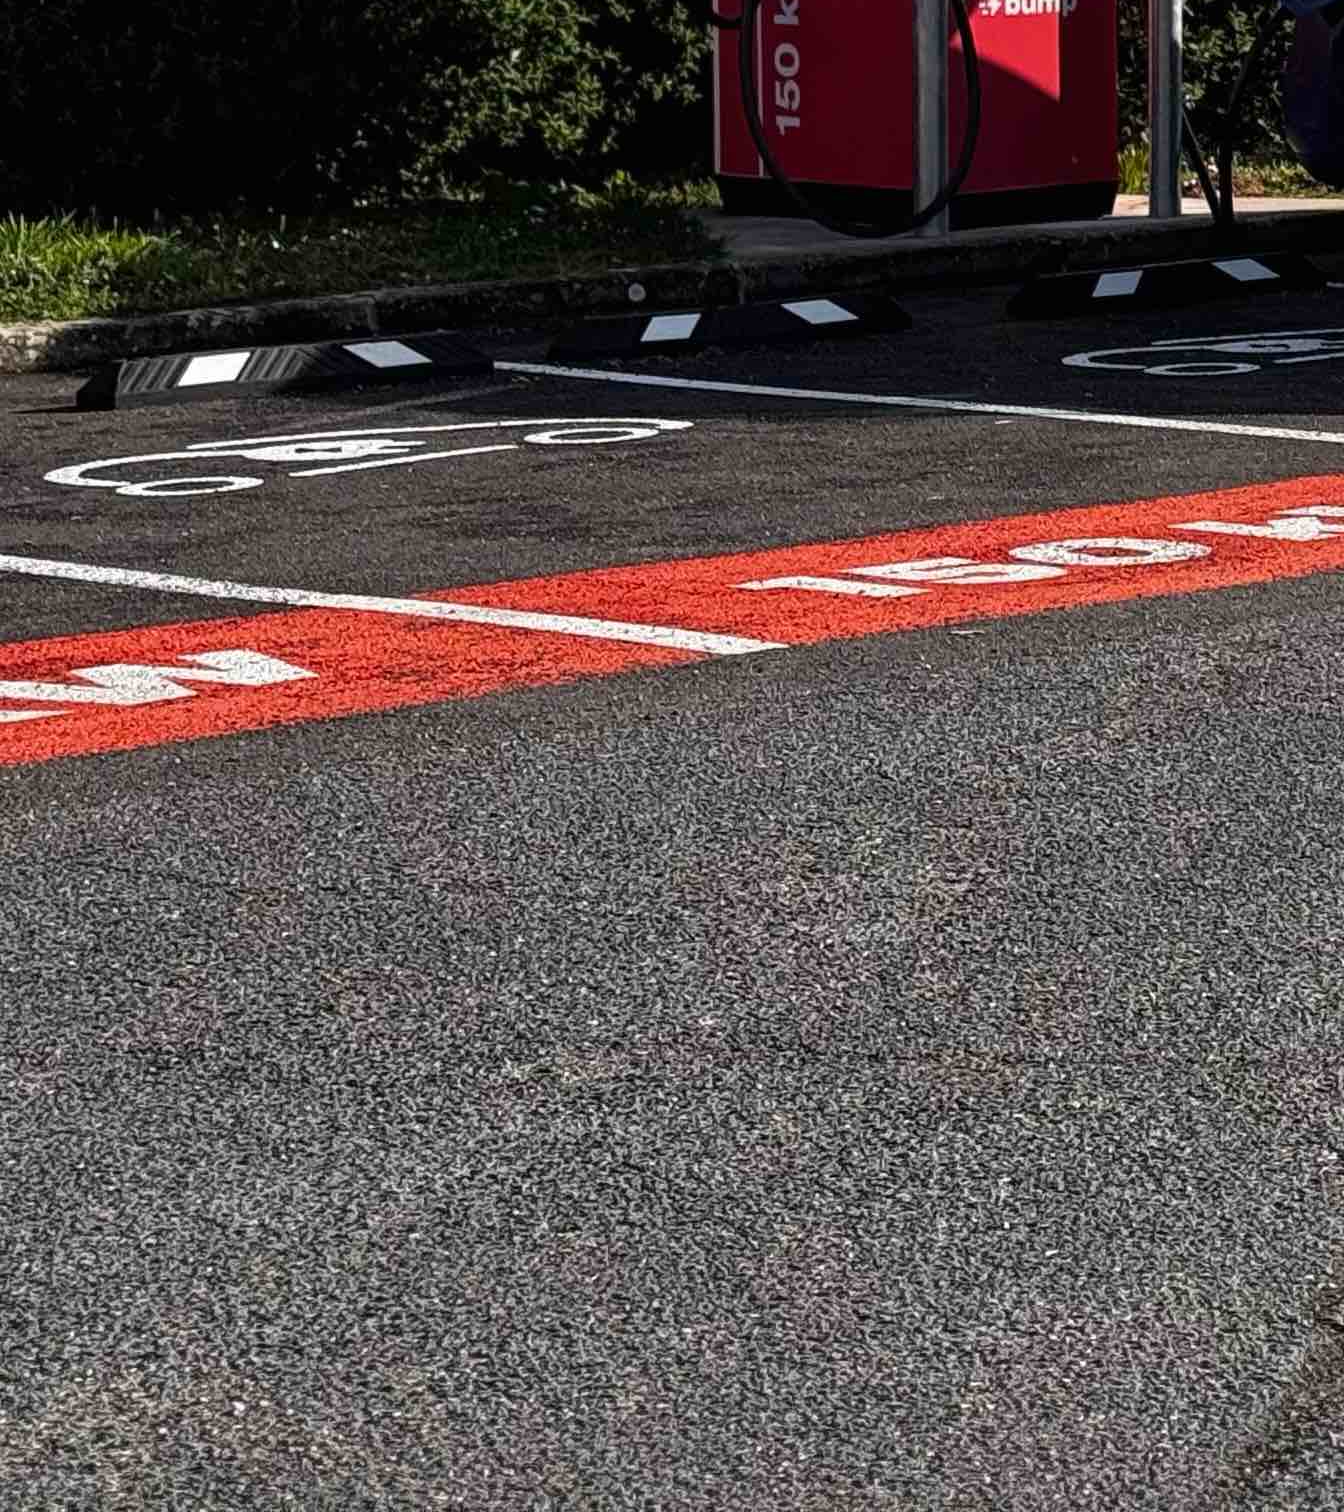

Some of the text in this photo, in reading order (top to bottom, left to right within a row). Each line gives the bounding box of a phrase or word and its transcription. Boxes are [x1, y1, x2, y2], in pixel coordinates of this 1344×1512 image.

[773, 42, 801, 137] 150
[726, 535, 1215, 598] 150
[0, 648, 320, 724] W
